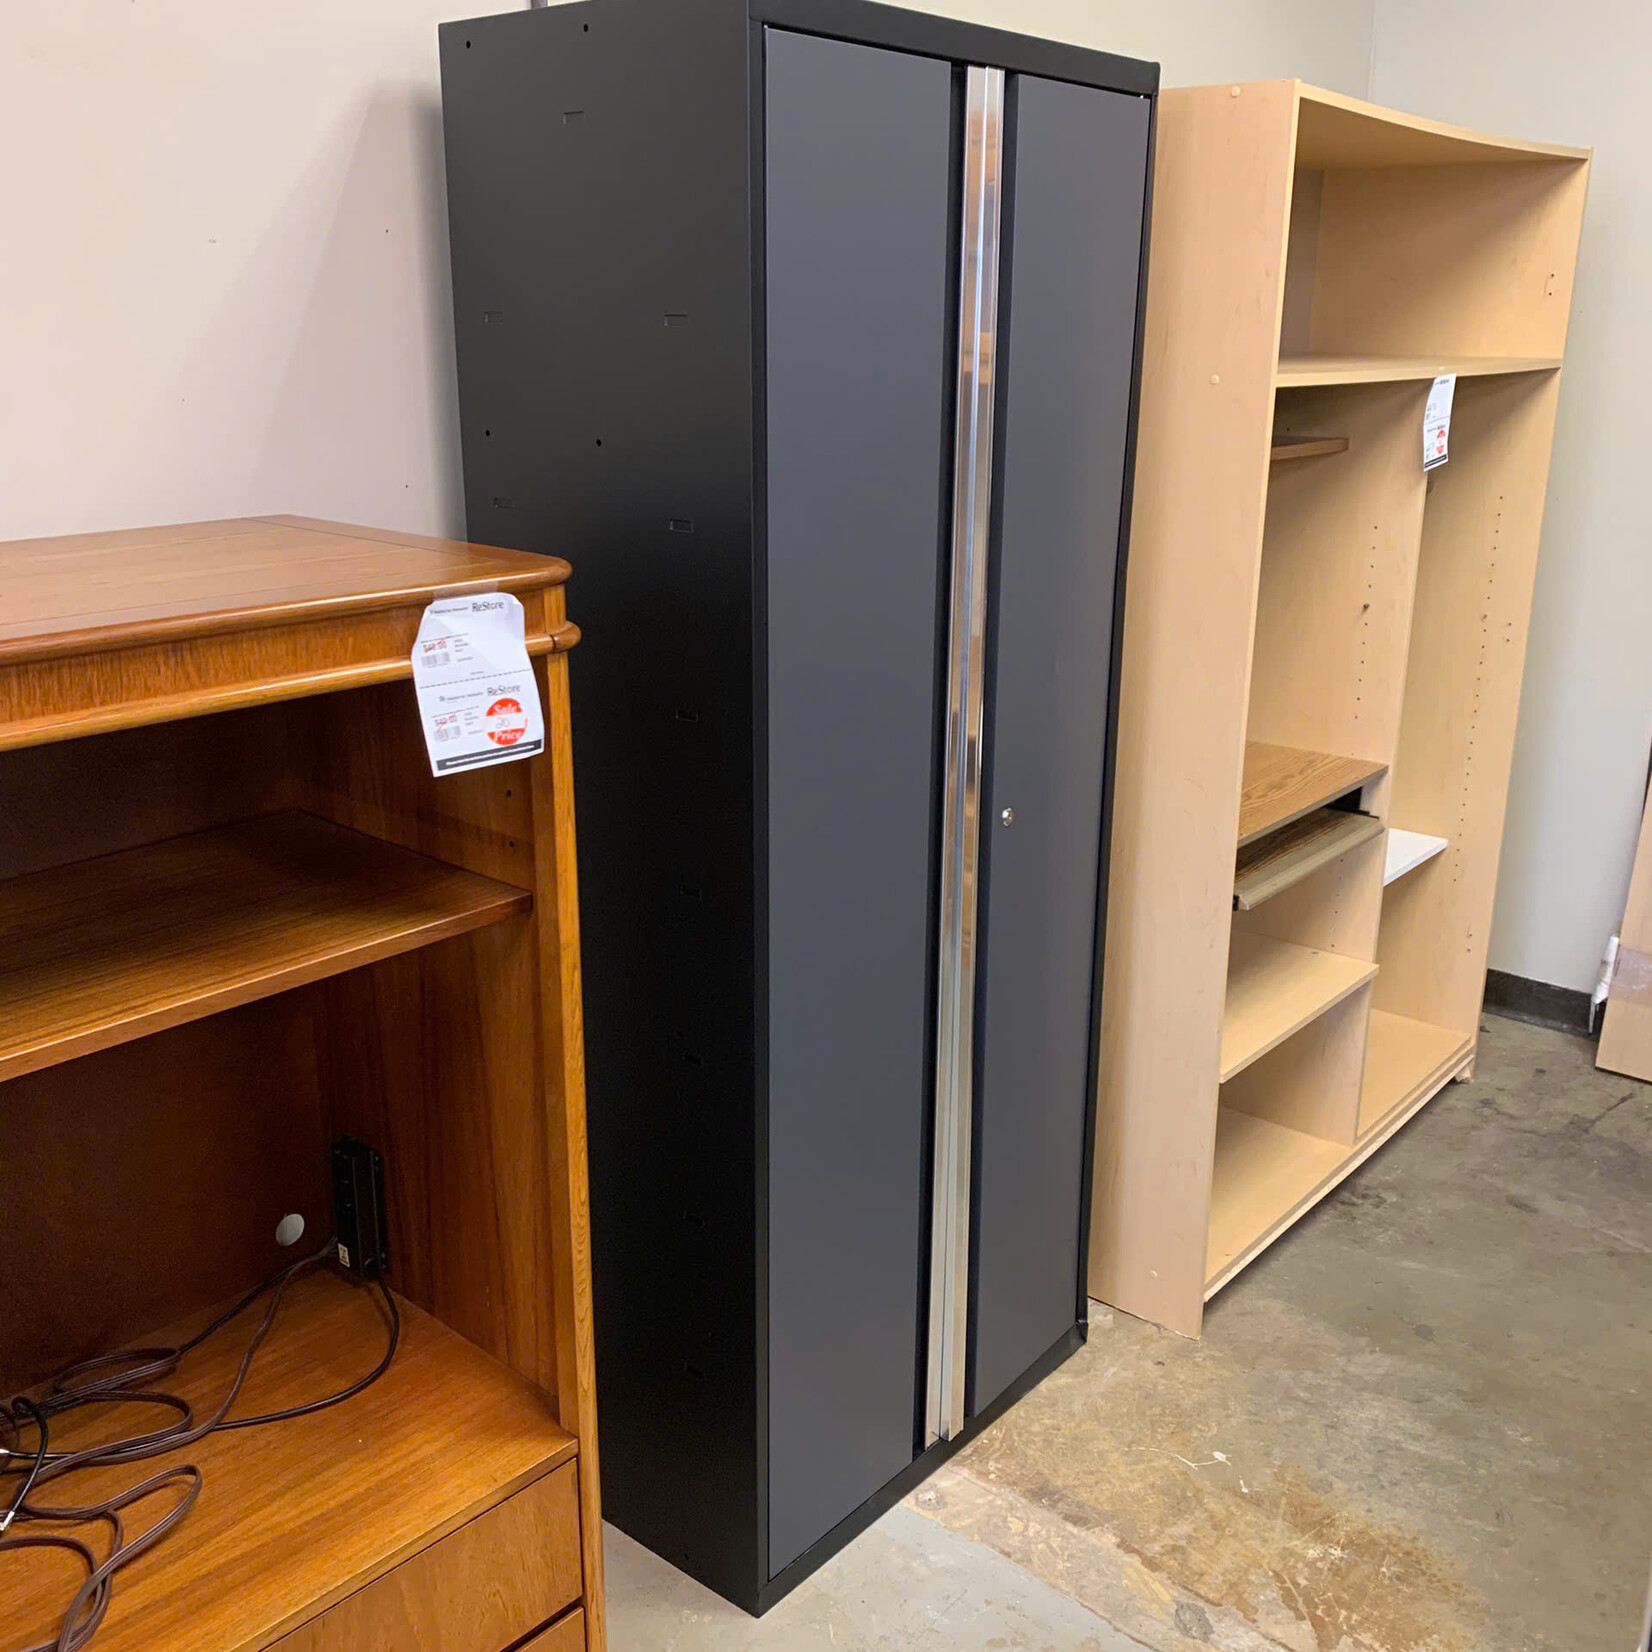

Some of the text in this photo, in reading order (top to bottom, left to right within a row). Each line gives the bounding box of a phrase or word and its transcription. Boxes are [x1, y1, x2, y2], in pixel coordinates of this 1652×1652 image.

[472, 601, 504, 612] ReStore
[487, 685, 520, 697] ReStore
[494, 703, 517, 714] Sale
[494, 730, 523, 741] Price
